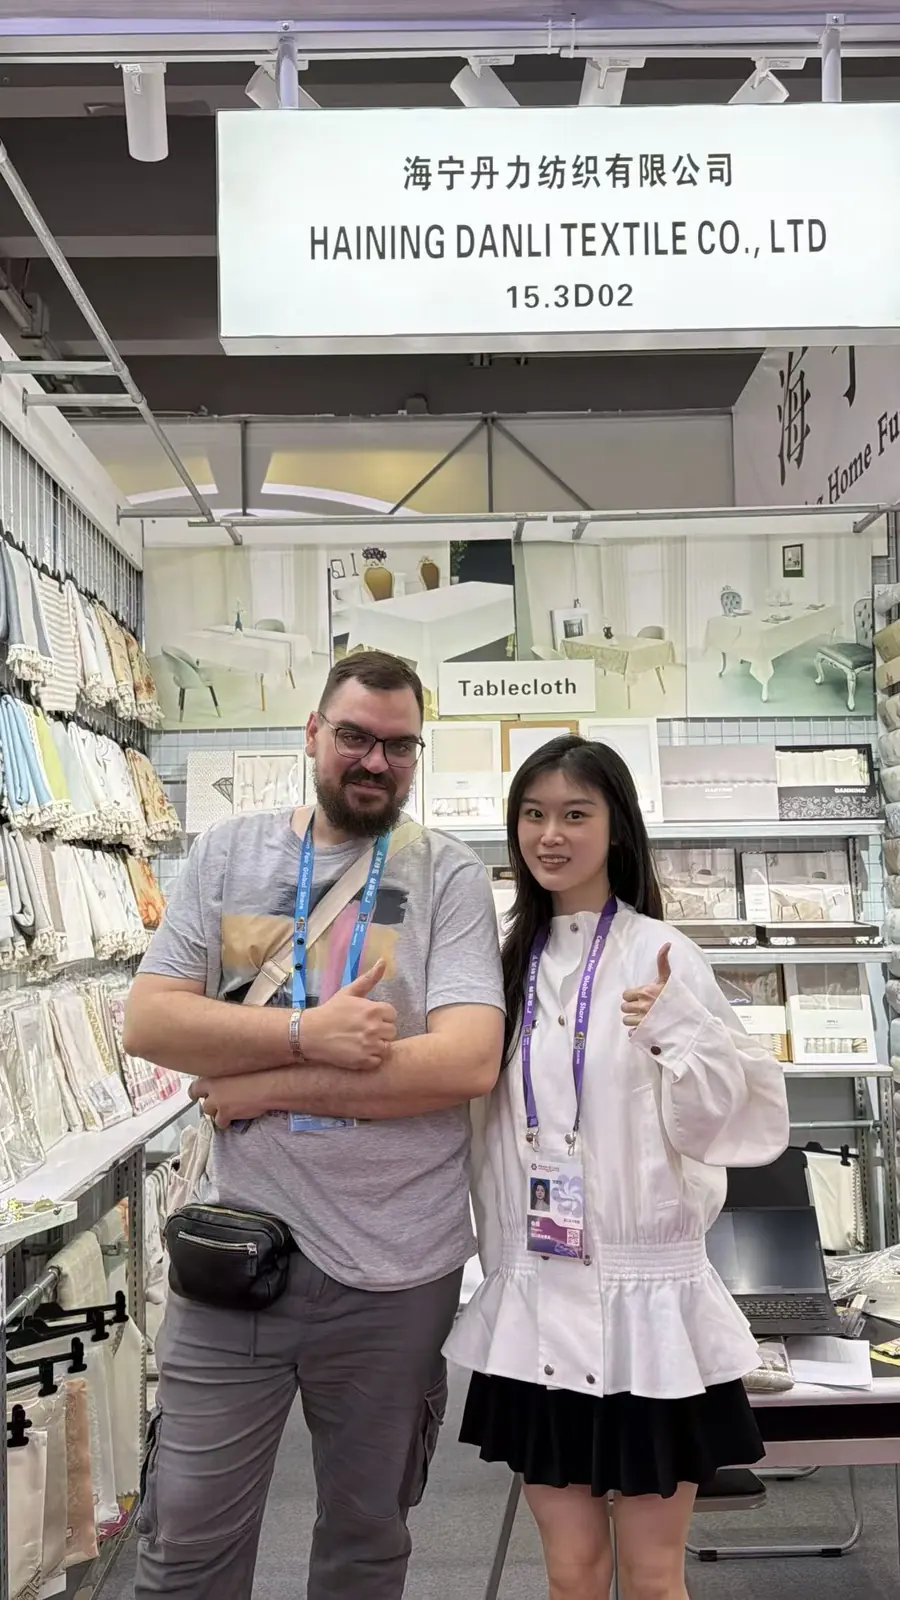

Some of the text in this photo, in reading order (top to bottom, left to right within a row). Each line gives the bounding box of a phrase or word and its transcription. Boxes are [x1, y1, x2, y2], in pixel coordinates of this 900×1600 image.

[403, 153, 733, 191] 海宁丹力纺织有限公司
[311, 218, 827, 260] HAINING DANLI TEXTILE CO., LTD
[507, 283, 633, 308] 15.3D02
[828, 411, 900, 505] Home Fu
[458, 677, 577, 697] Tablecloth
[301, 866, 309, 888] Global
[578, 935, 603, 1024] Canton Fair Global Share
